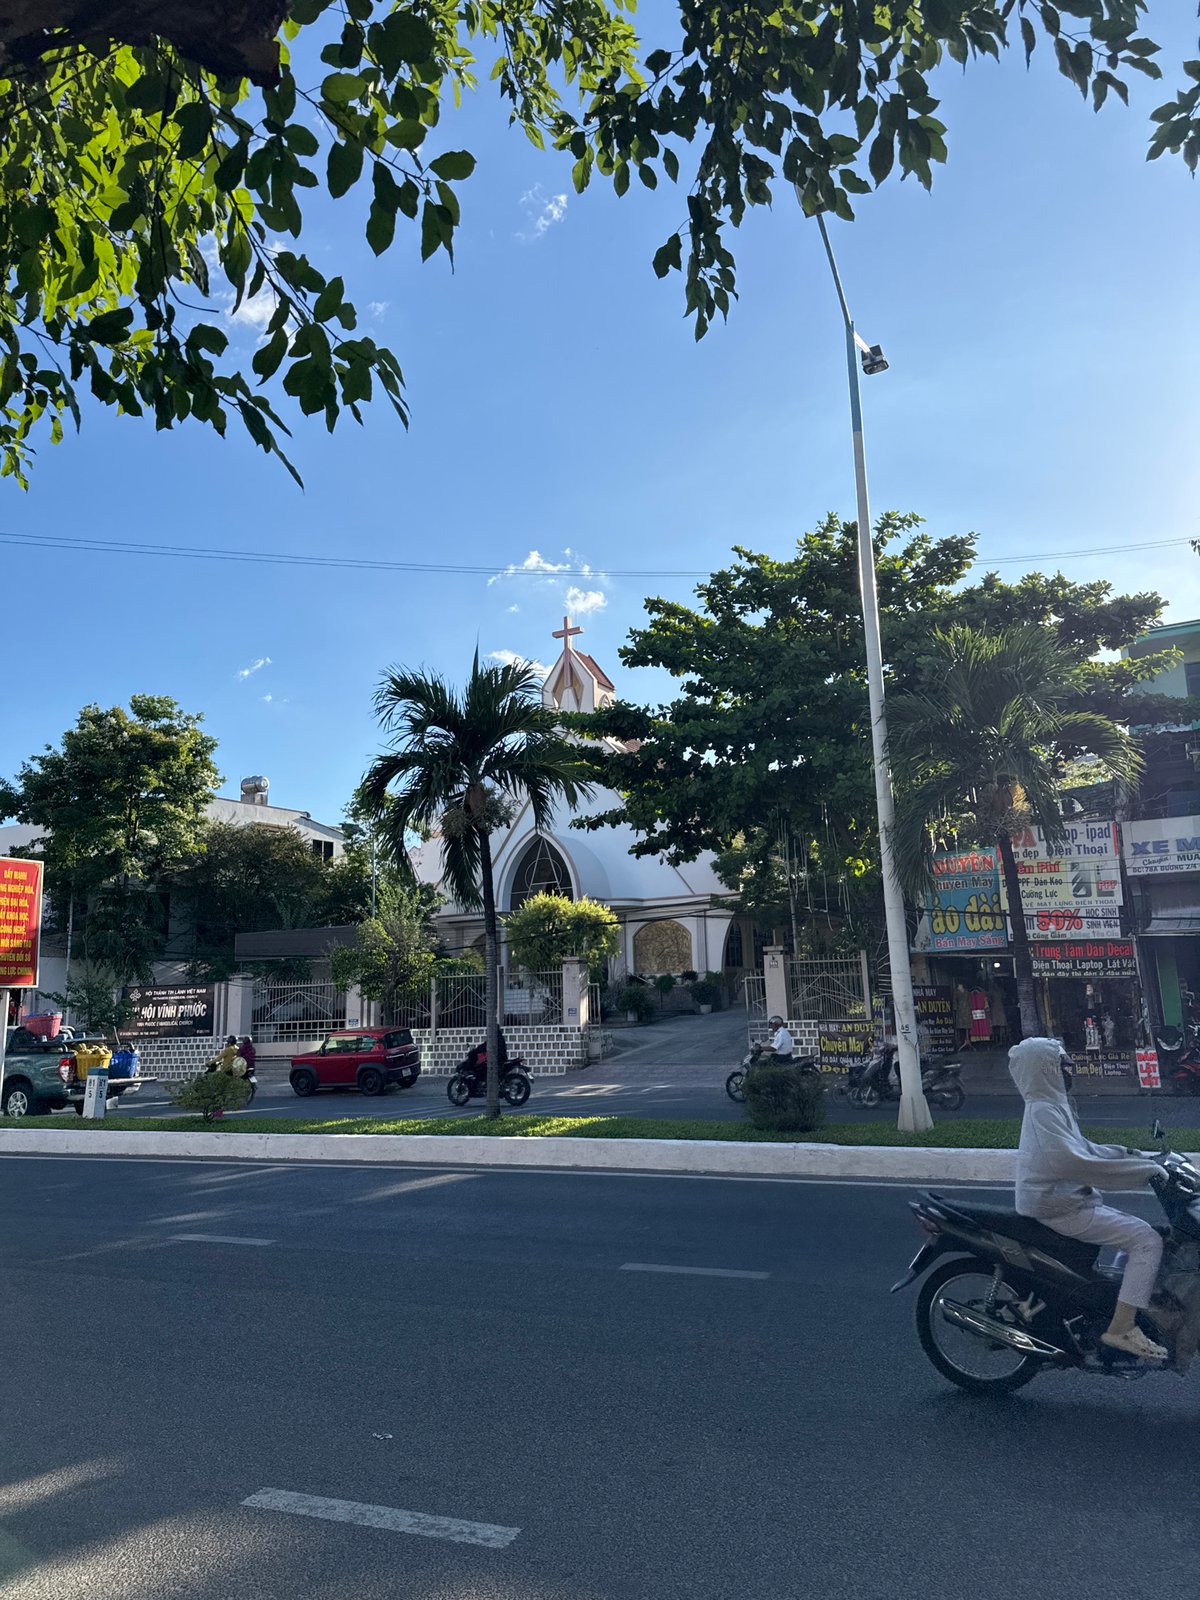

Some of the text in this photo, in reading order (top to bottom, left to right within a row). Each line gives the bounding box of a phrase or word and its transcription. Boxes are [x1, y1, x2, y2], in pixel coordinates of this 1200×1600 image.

[1075, 843, 1108, 857] Thoại
[1131, 840, 1170, 855] XE
[933, 851, 994, 875] DUYÊN
[971, 875, 994, 889] May
[931, 893, 1004, 935] áo dài
[1101, 907, 1117, 916] SINH
[1037, 908, 1083, 931] 50%
[1086, 919, 1100, 929] SINH
[957, 935, 976, 946] May
[1034, 944, 1061, 960] Trung
[1107, 942, 1133, 956] Decal
[1032, 960, 1050, 971] Điện
[157, 1002, 177, 1018] VĨNH
[178, 1001, 207, 1018] PHƯỚC
[841, 1023, 853, 1032] AN
[821, 1035, 847, 1054] Chuyên
